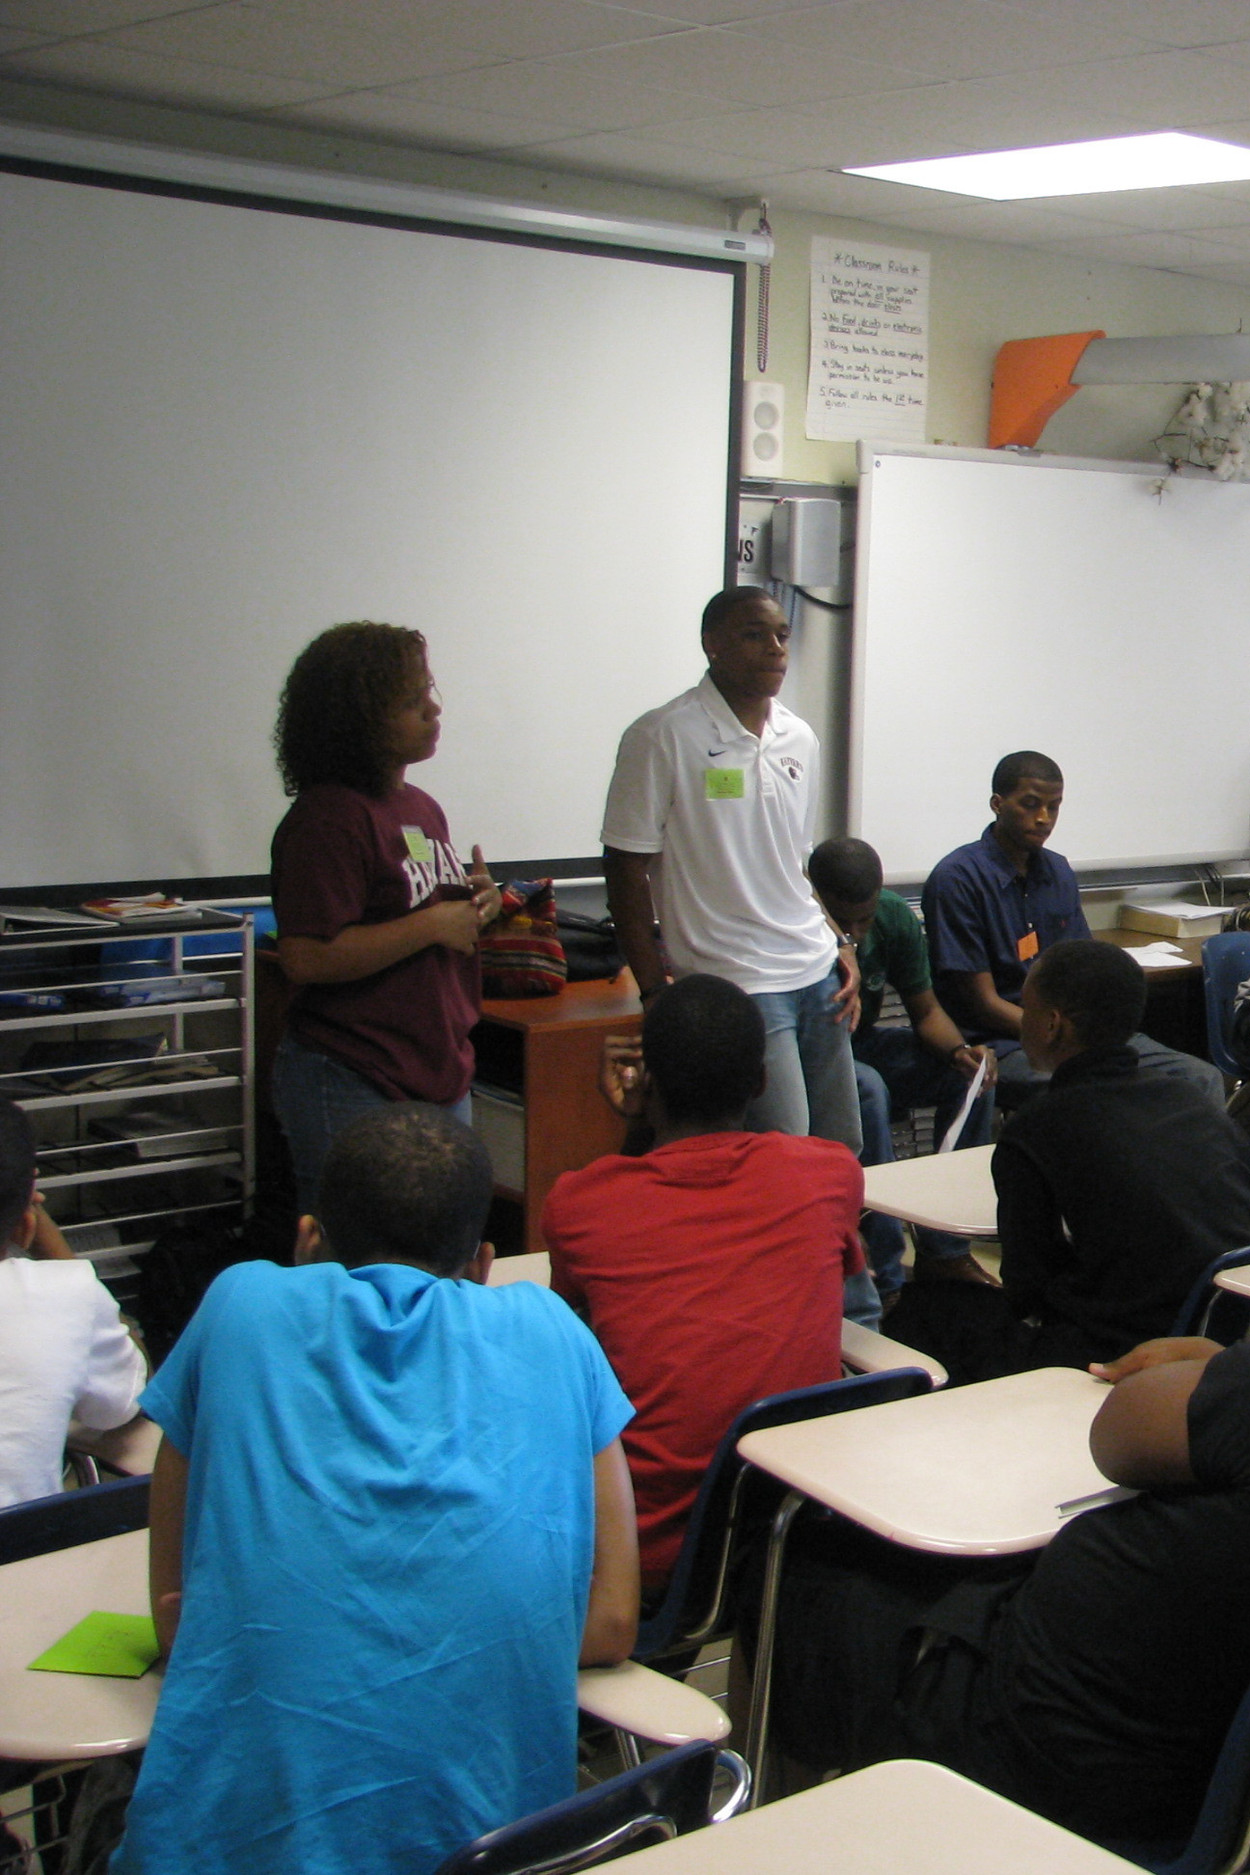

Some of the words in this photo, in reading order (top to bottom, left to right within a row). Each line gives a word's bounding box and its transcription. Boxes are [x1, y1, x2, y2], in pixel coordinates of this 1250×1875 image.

[844, 254, 882, 271] Classroom
[888, 260, 910, 274] Rules
[844, 280, 853, 288] on
[886, 286, 899, 296] your
[904, 286, 918, 296] seat
[858, 290, 871, 298] with
[829, 312, 839, 323] No
[830, 340, 848, 354] Bring
[852, 344, 870, 354] books
[872, 346, 879, 355] to
[881, 348, 896, 357] class
[830, 359, 844, 372] Stay
[855, 363, 870, 372] seats
[874, 365, 894, 375] unless
[911, 368, 924, 378] have
[829, 387, 847, 399] Follow
[850, 391, 859, 399] all
[863, 391, 878, 401] rules
[882, 393, 892, 402] the
